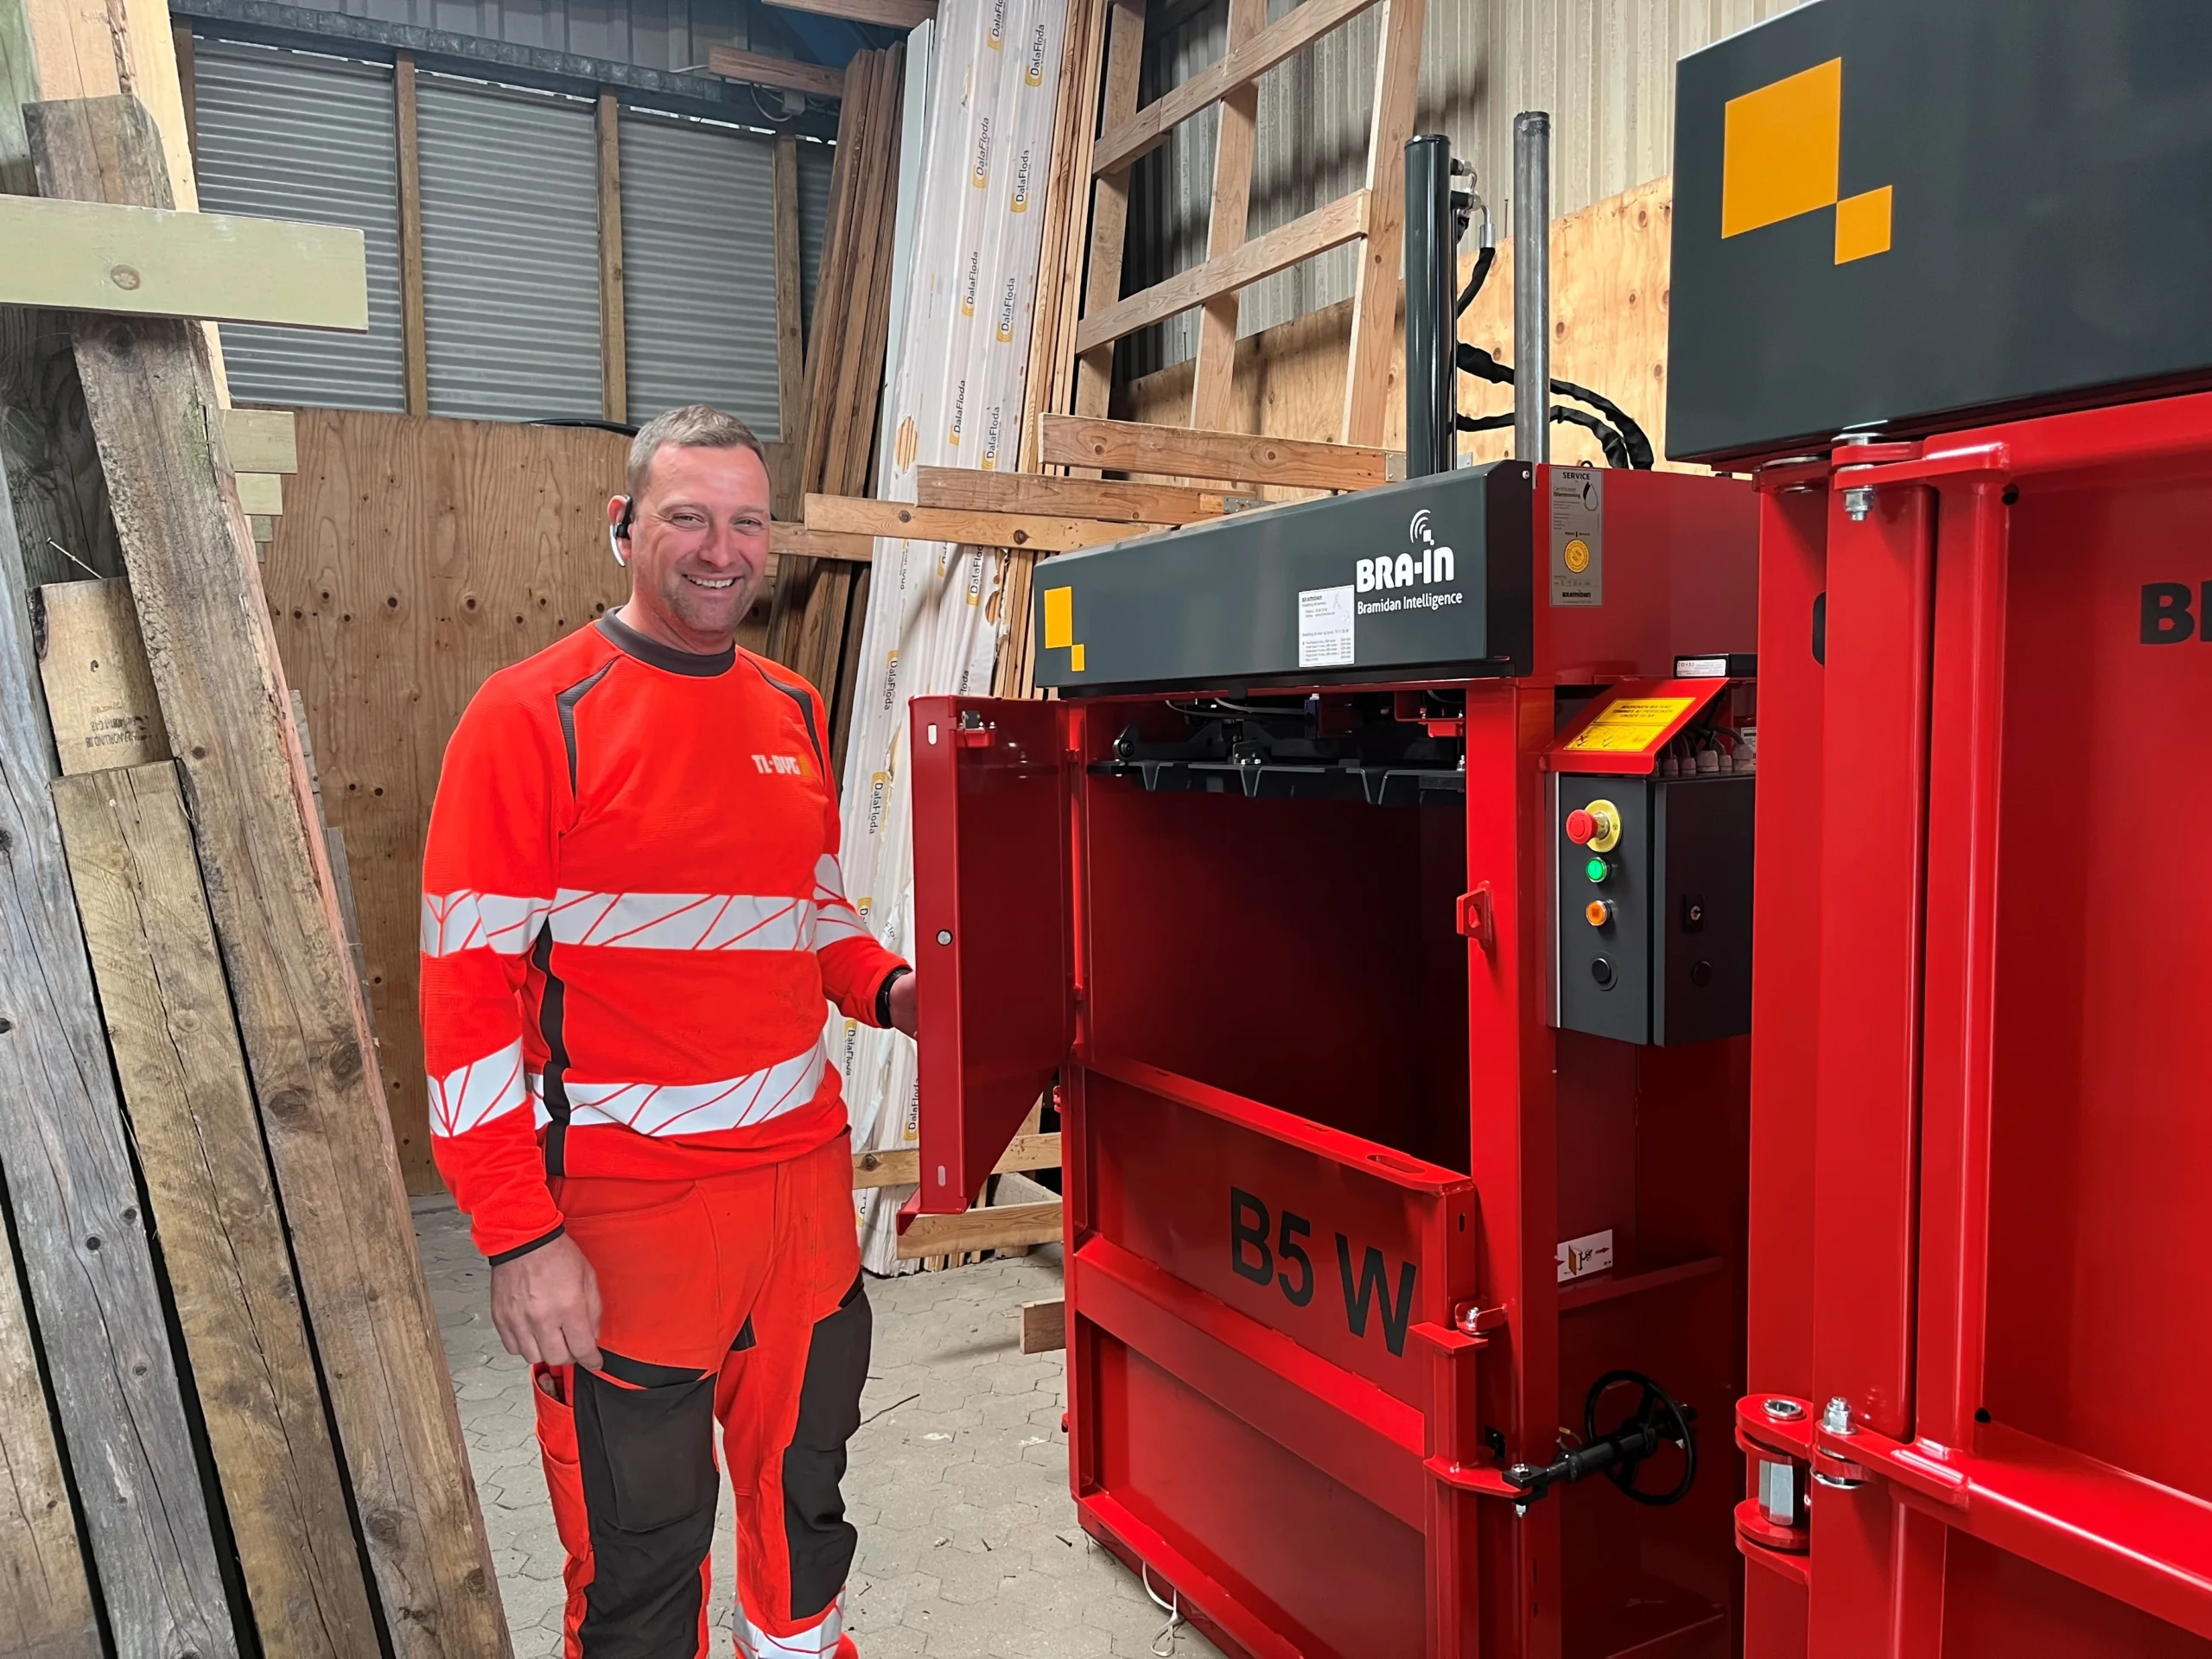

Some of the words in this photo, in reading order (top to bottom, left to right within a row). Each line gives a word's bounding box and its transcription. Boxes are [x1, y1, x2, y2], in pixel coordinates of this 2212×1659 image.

[1030, 24, 1045, 76] DalaFloda
[976, 118, 989, 176] DalaFloda
[1015, 149, 1030, 202] DalaFloda
[967, 251, 978, 305] DalaFloda
[1001, 277, 1015, 332] DalaFloda
[953, 380, 965, 434] DalaFloda
[987, 406, 1000, 459] DalaFloda
[1357, 596, 1402, 615] Bramidan
[1402, 592, 1463, 612] Intelligence
[883, 660, 899, 710] DalaFloda
[868, 782, 884, 835] DalaFloda
[1230, 1185, 1314, 1307] B5
[1334, 1231, 1417, 1358] W
